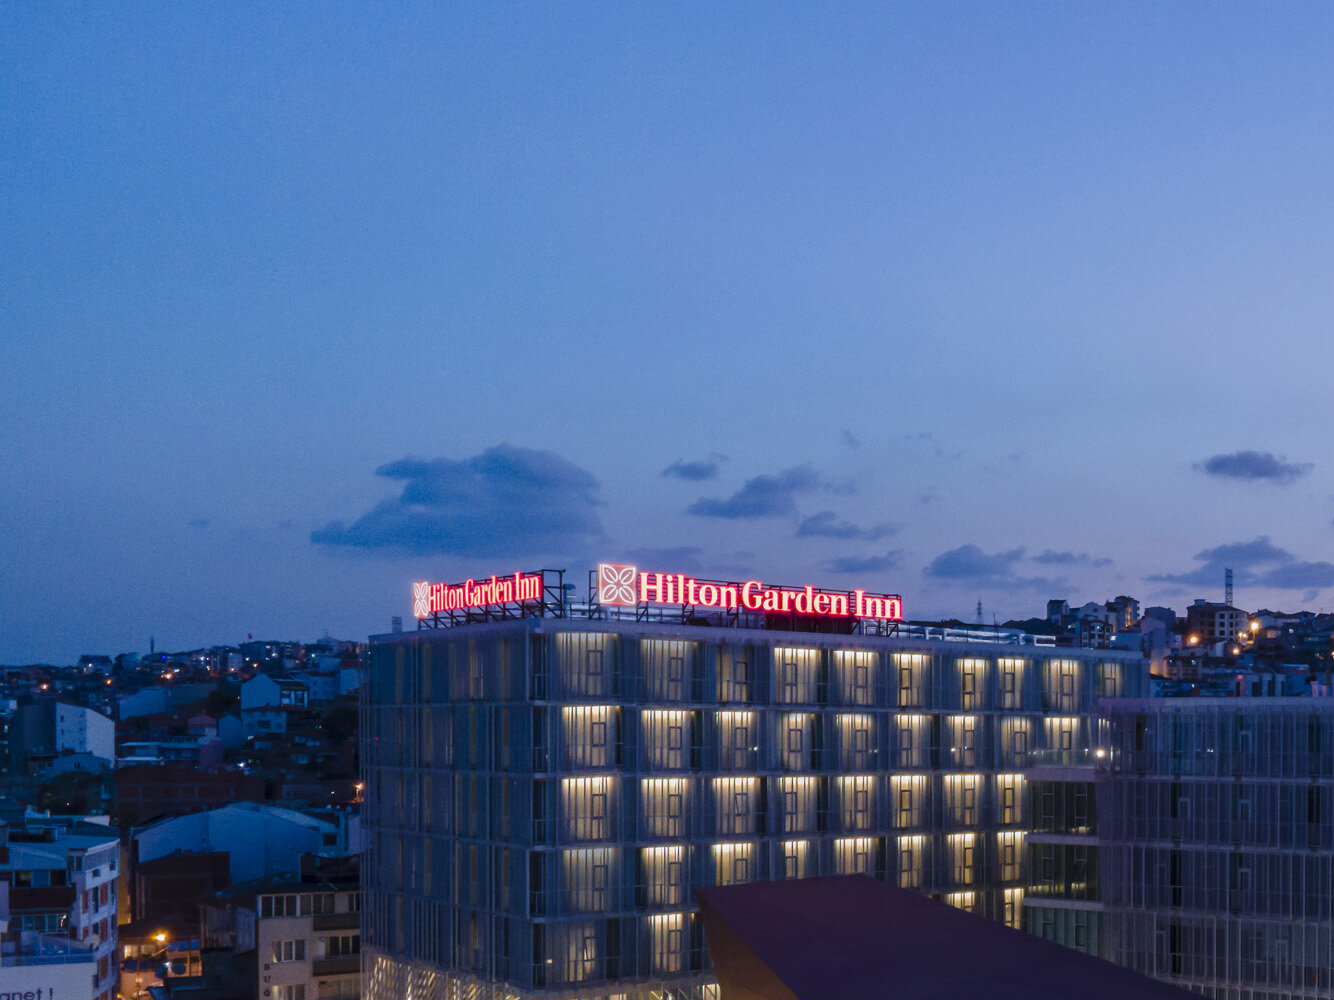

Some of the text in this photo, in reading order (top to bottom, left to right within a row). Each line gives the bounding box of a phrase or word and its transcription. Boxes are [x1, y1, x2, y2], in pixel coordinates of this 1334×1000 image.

[427, 571, 541, 613] Hilton Garden Inn
[639, 571, 902, 620] Hilton Garden Inn
